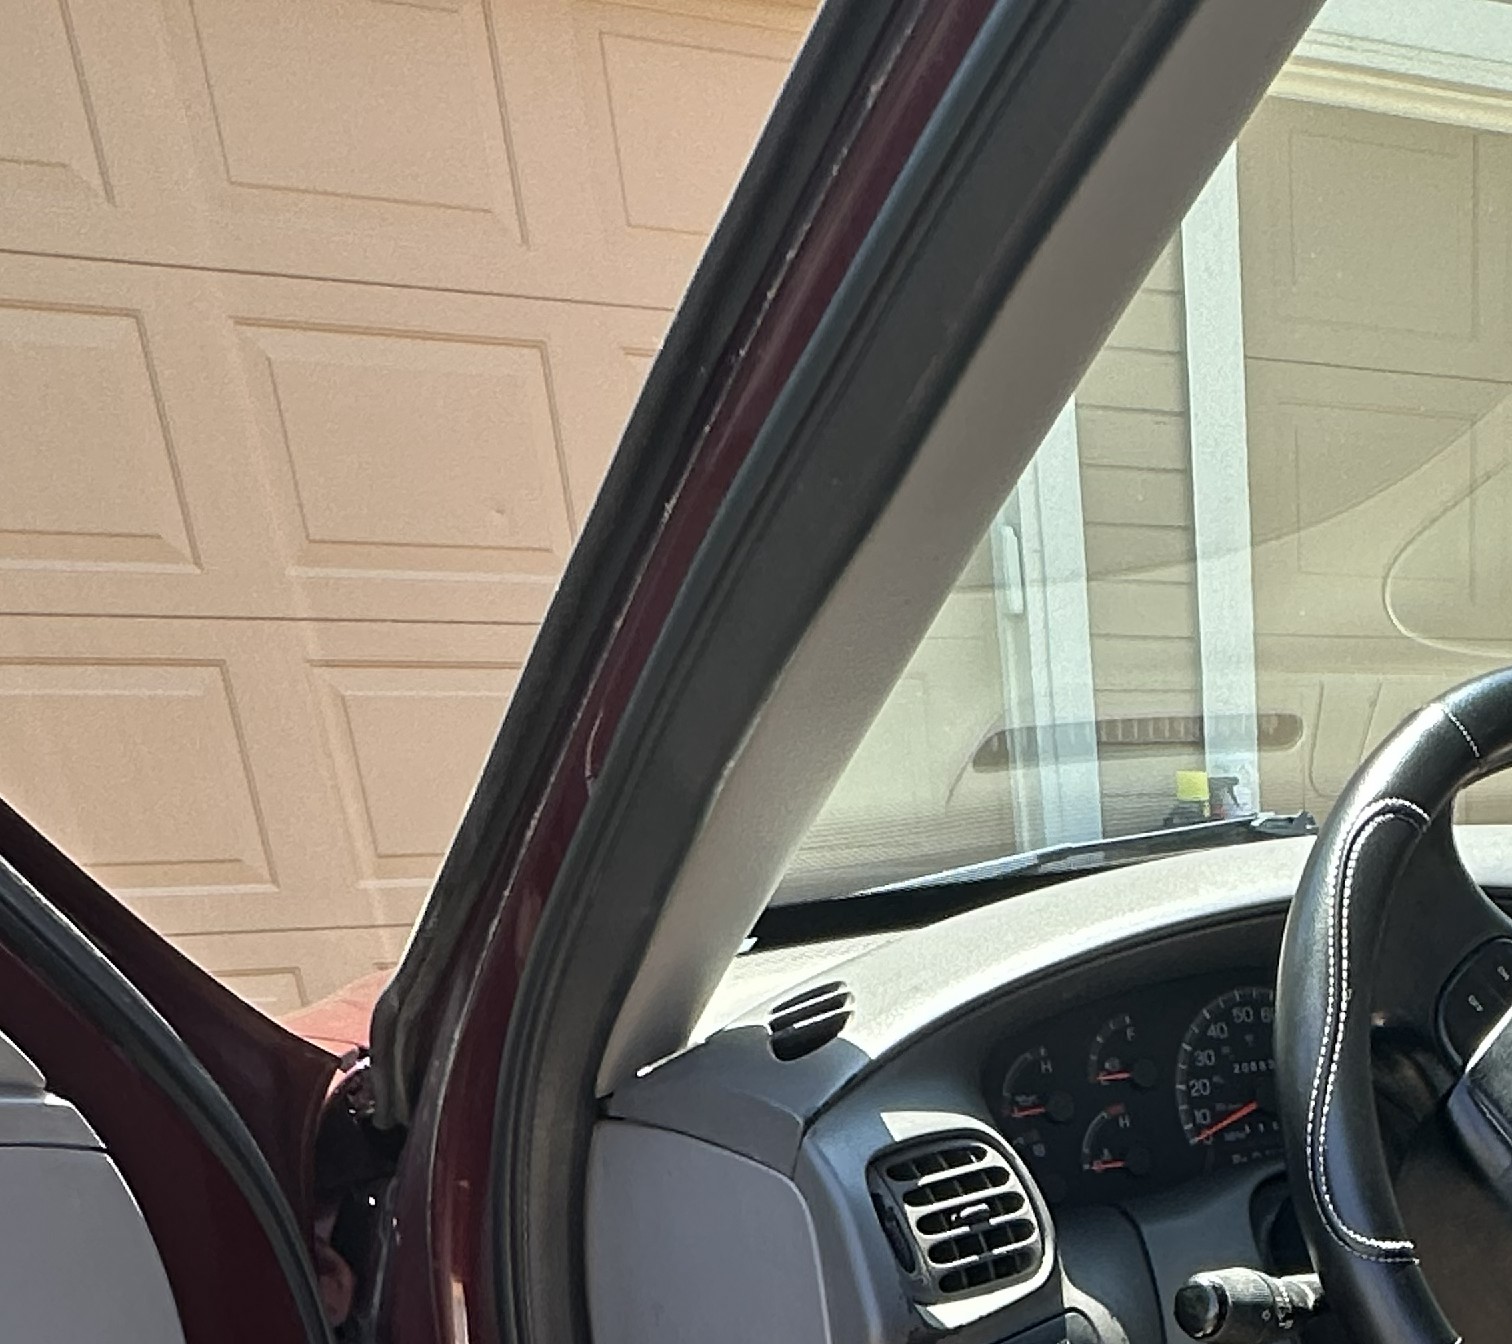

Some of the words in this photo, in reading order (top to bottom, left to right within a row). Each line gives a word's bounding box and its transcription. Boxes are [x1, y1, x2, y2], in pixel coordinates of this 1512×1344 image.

[1232, 1007, 1253, 1023] 50
[1207, 1022, 1228, 1039] 40
[1040, 1059, 1053, 1073] H
[1194, 1050, 1215, 1066] 30
[1189, 1079, 1211, 1097] 20
[1118, 1113, 1130, 1128] H
[1194, 1108, 1211, 1124] 10
